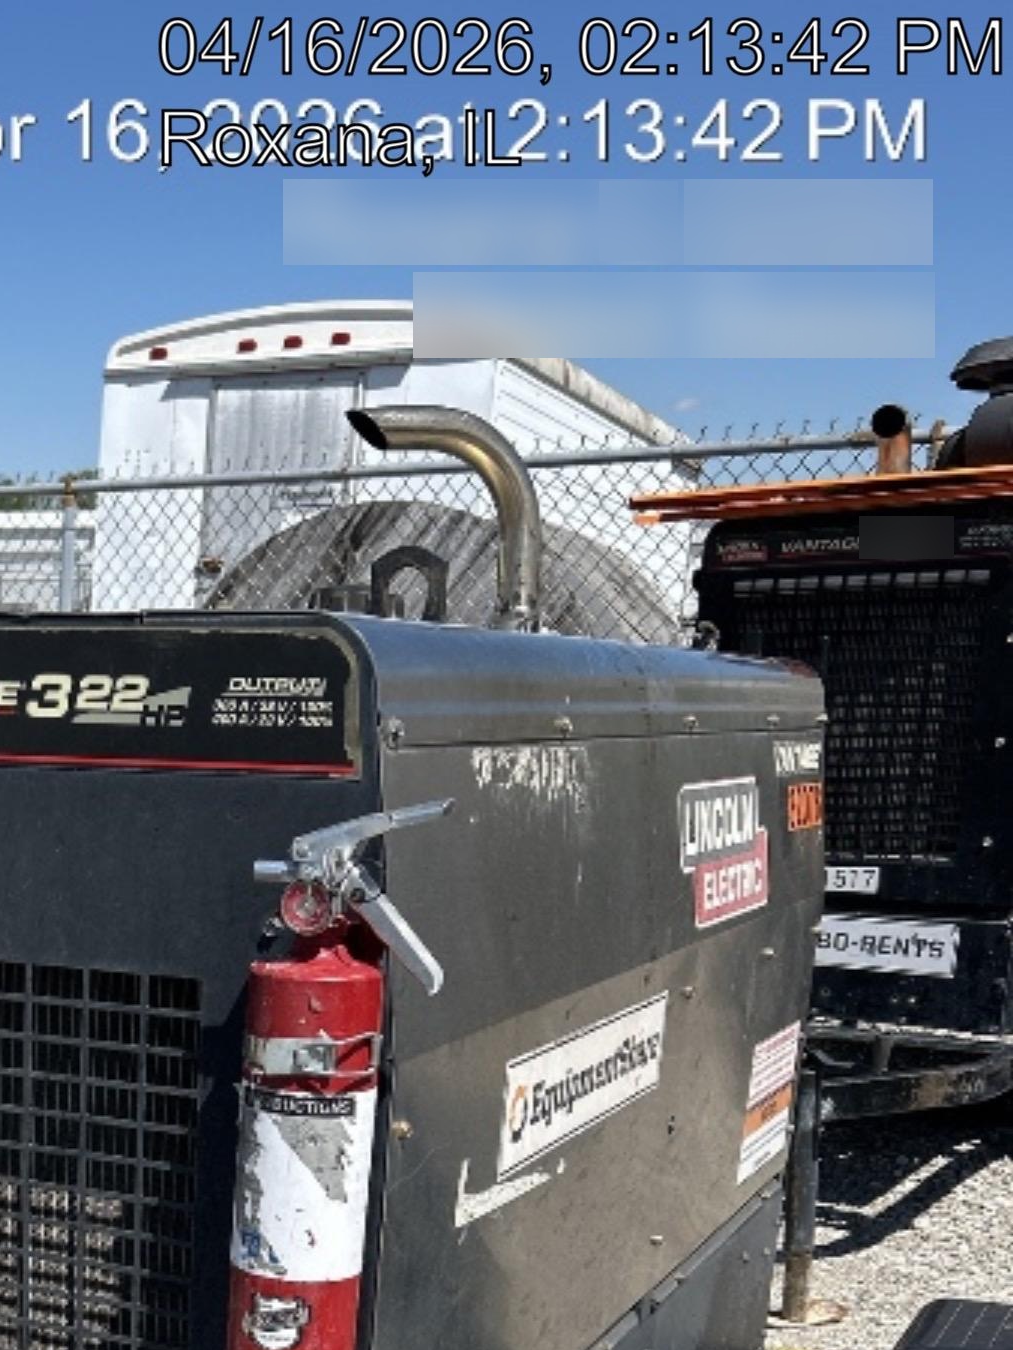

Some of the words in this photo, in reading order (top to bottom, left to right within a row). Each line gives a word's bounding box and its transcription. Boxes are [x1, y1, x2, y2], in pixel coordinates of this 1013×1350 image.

[25, 673, 151, 718] 322
[685, 791, 754, 856] LINCOLN
[702, 857, 763, 911] ELECTRIC
[824, 868, 876, 889] 577
